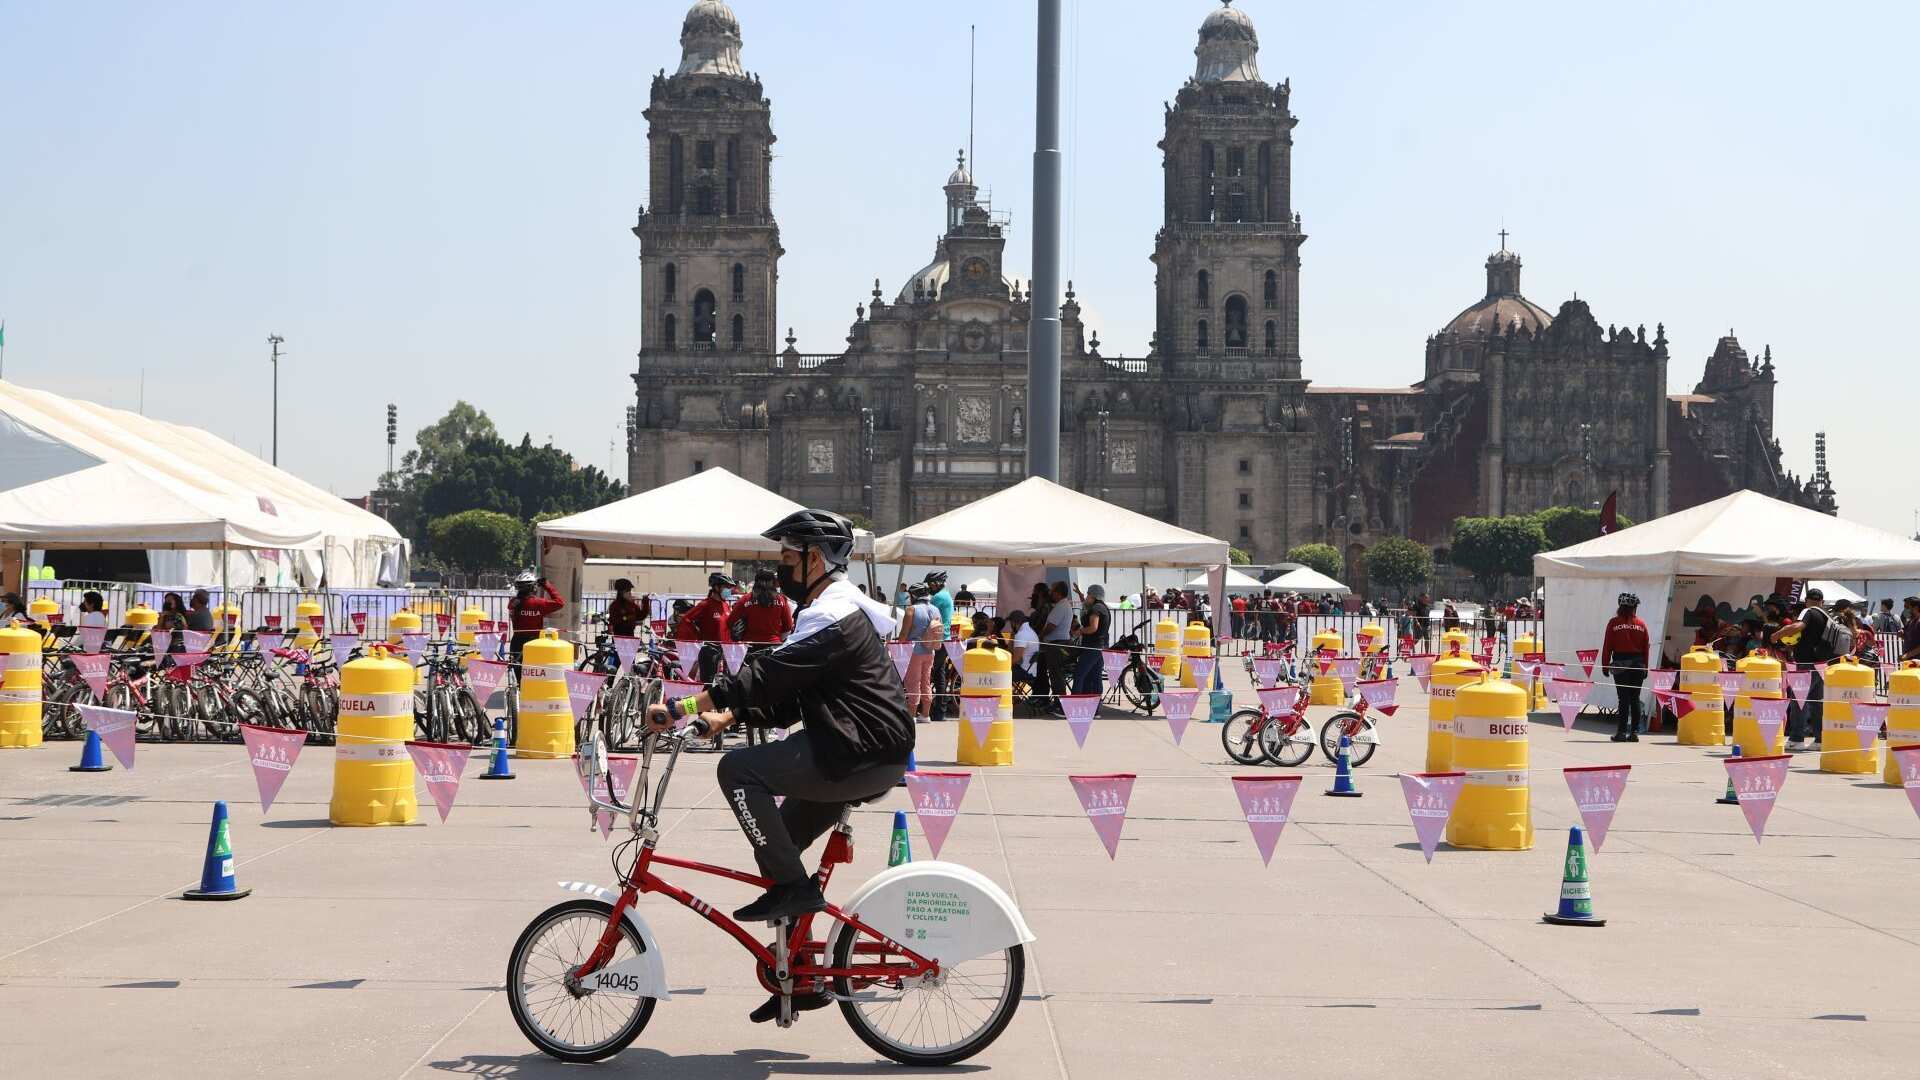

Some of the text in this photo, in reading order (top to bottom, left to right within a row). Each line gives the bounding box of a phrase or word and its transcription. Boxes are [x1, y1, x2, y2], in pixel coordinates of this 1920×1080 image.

[339, 700, 376, 711] CUELA
[733, 788, 767, 846] Reebok
[918, 899, 957, 907] PRIORIDAD
[594, 973, 639, 991] 14045
